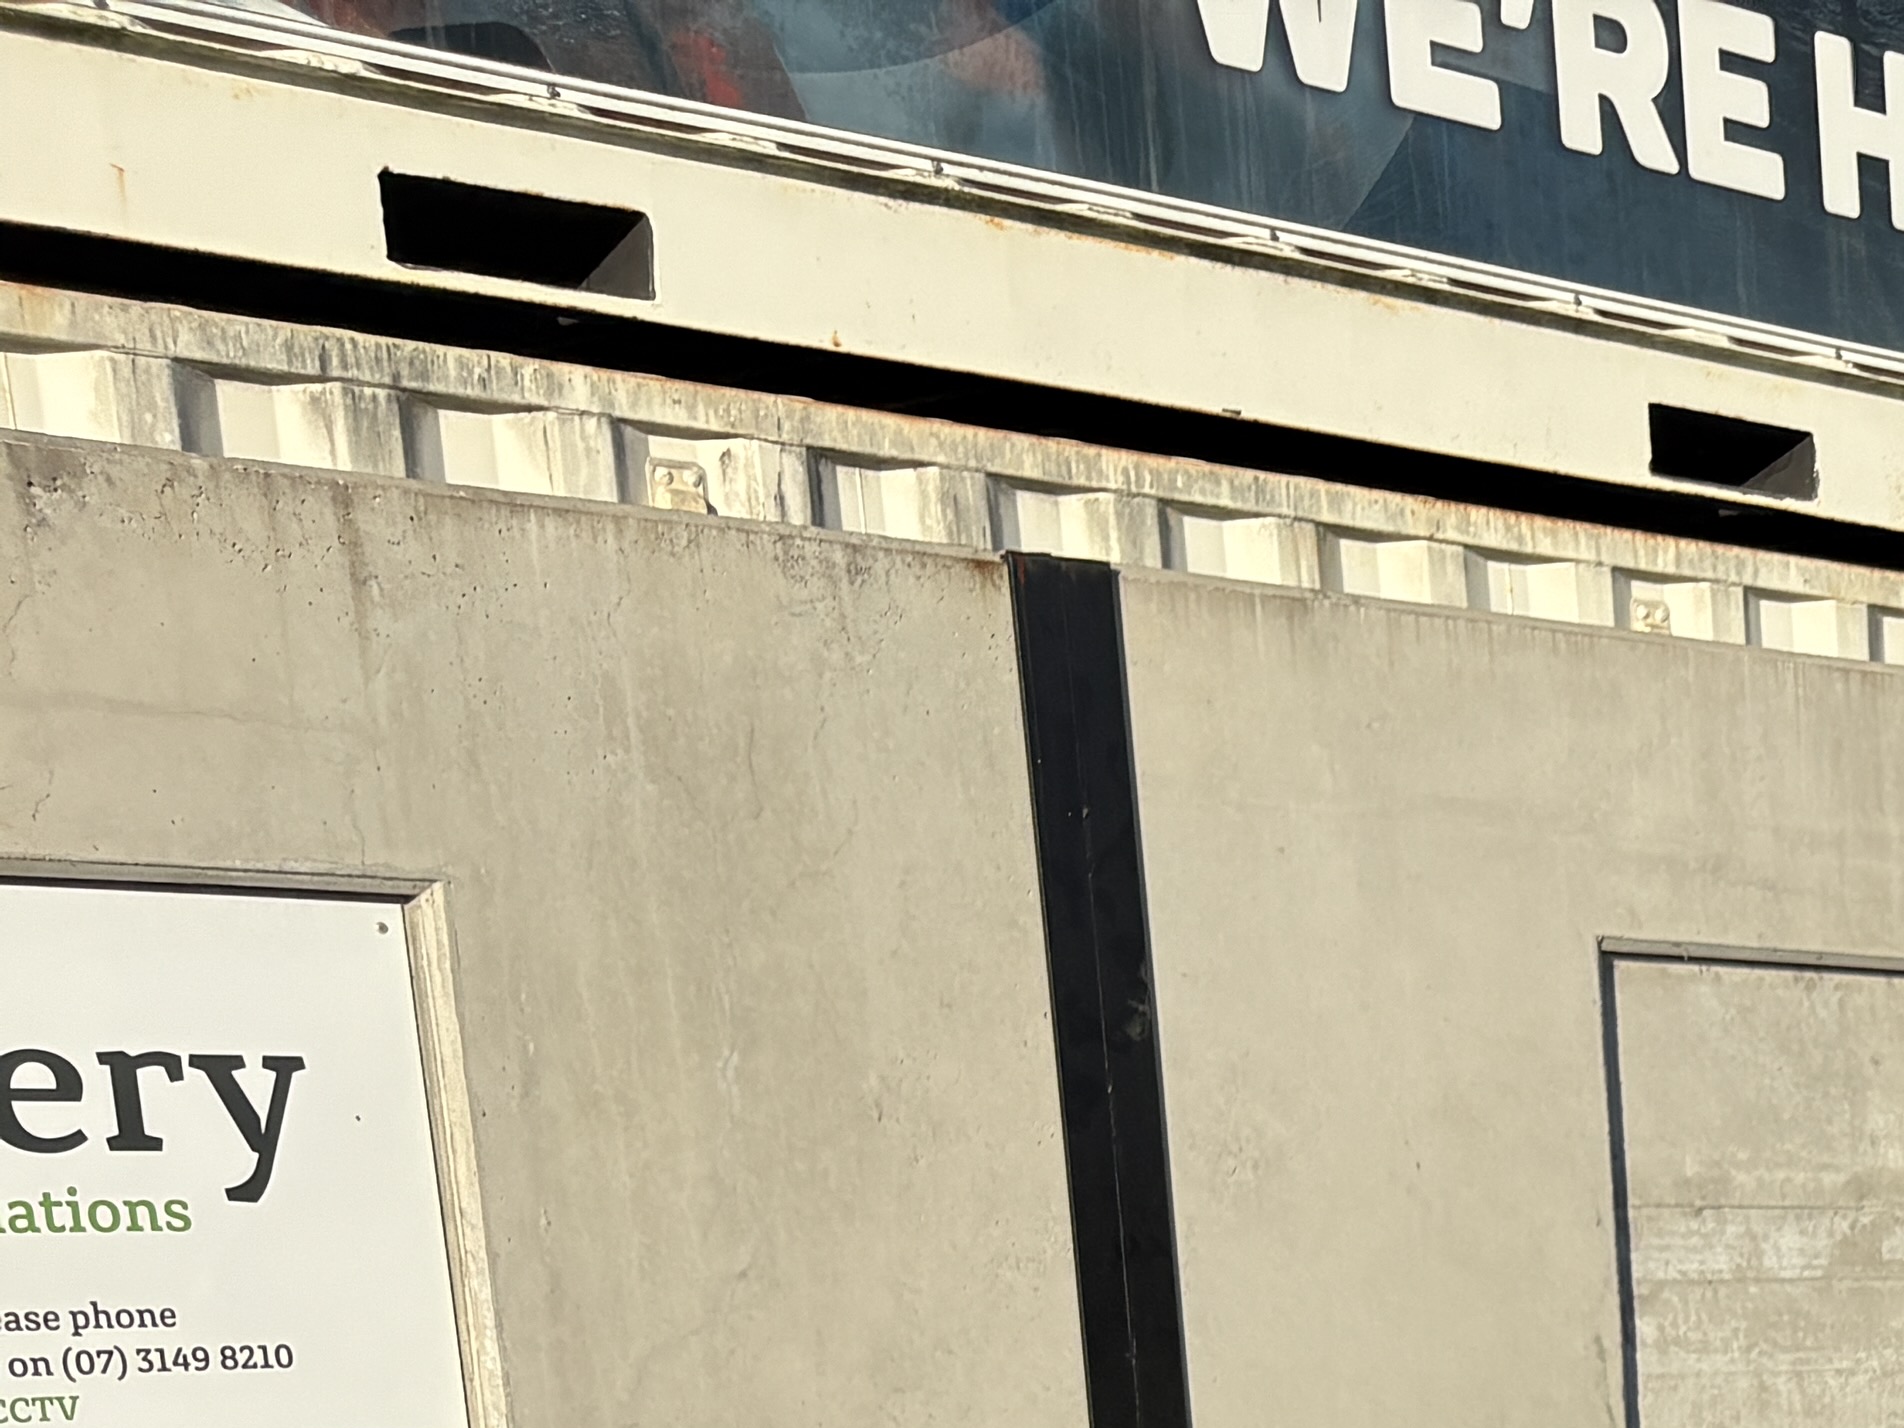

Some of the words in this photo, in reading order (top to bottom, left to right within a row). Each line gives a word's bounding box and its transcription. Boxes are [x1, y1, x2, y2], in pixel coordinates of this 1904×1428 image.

[0, 1186, 192, 1234] ations
[0, 1308, 61, 1333] ase
[69, 1301, 177, 1337] phone
[8, 1355, 54, 1379] on
[62, 1345, 128, 1383] (07)
[136, 1346, 210, 1373] 3149
[220, 1344, 294, 1371] 8210
